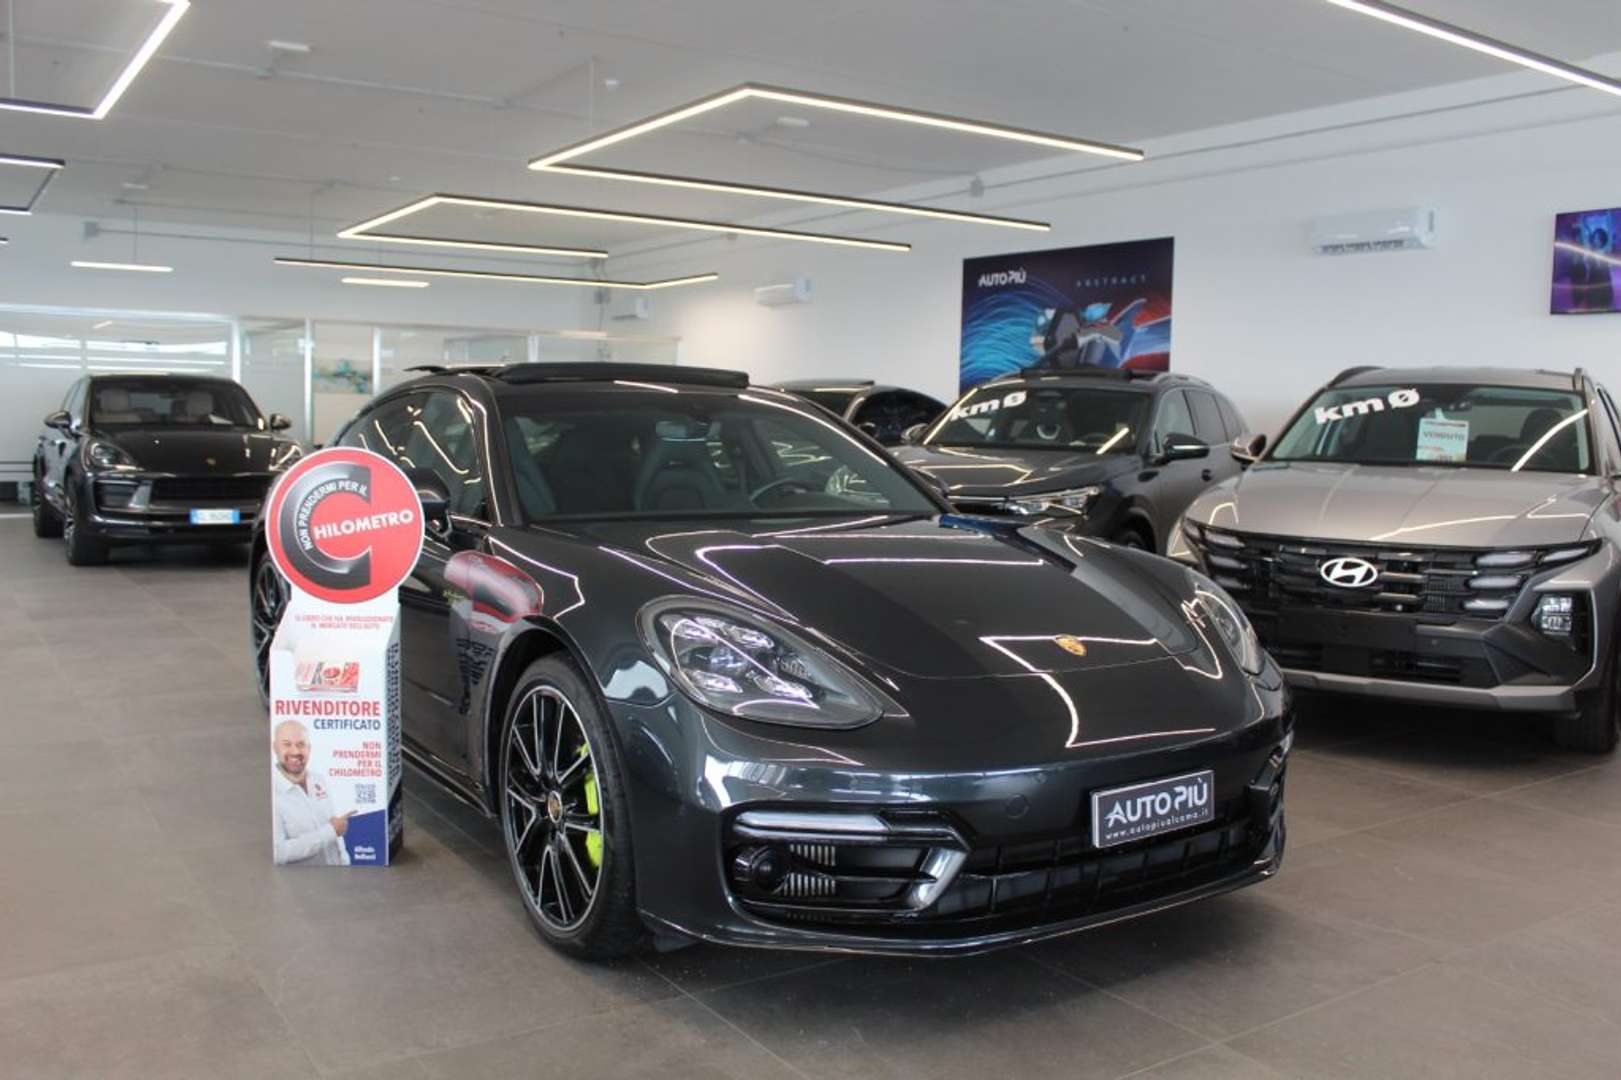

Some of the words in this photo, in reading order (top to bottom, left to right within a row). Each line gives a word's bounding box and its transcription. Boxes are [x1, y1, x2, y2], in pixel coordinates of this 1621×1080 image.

[950, 399, 1000, 421] km
[1314, 397, 1385, 425] km
[338, 481, 359, 492] PER
[299, 481, 337, 526] PRENDERMI
[298, 525, 313, 550] NON
[275, 700, 381, 717] RIVENDITORE
[313, 719, 381, 731] CERTIFICATO
[362, 741, 381, 750] NON
[332, 750, 381, 759] PRENDERMI
[358, 760, 372, 768] PER
[329, 768, 382, 777] CHILOMETRO
